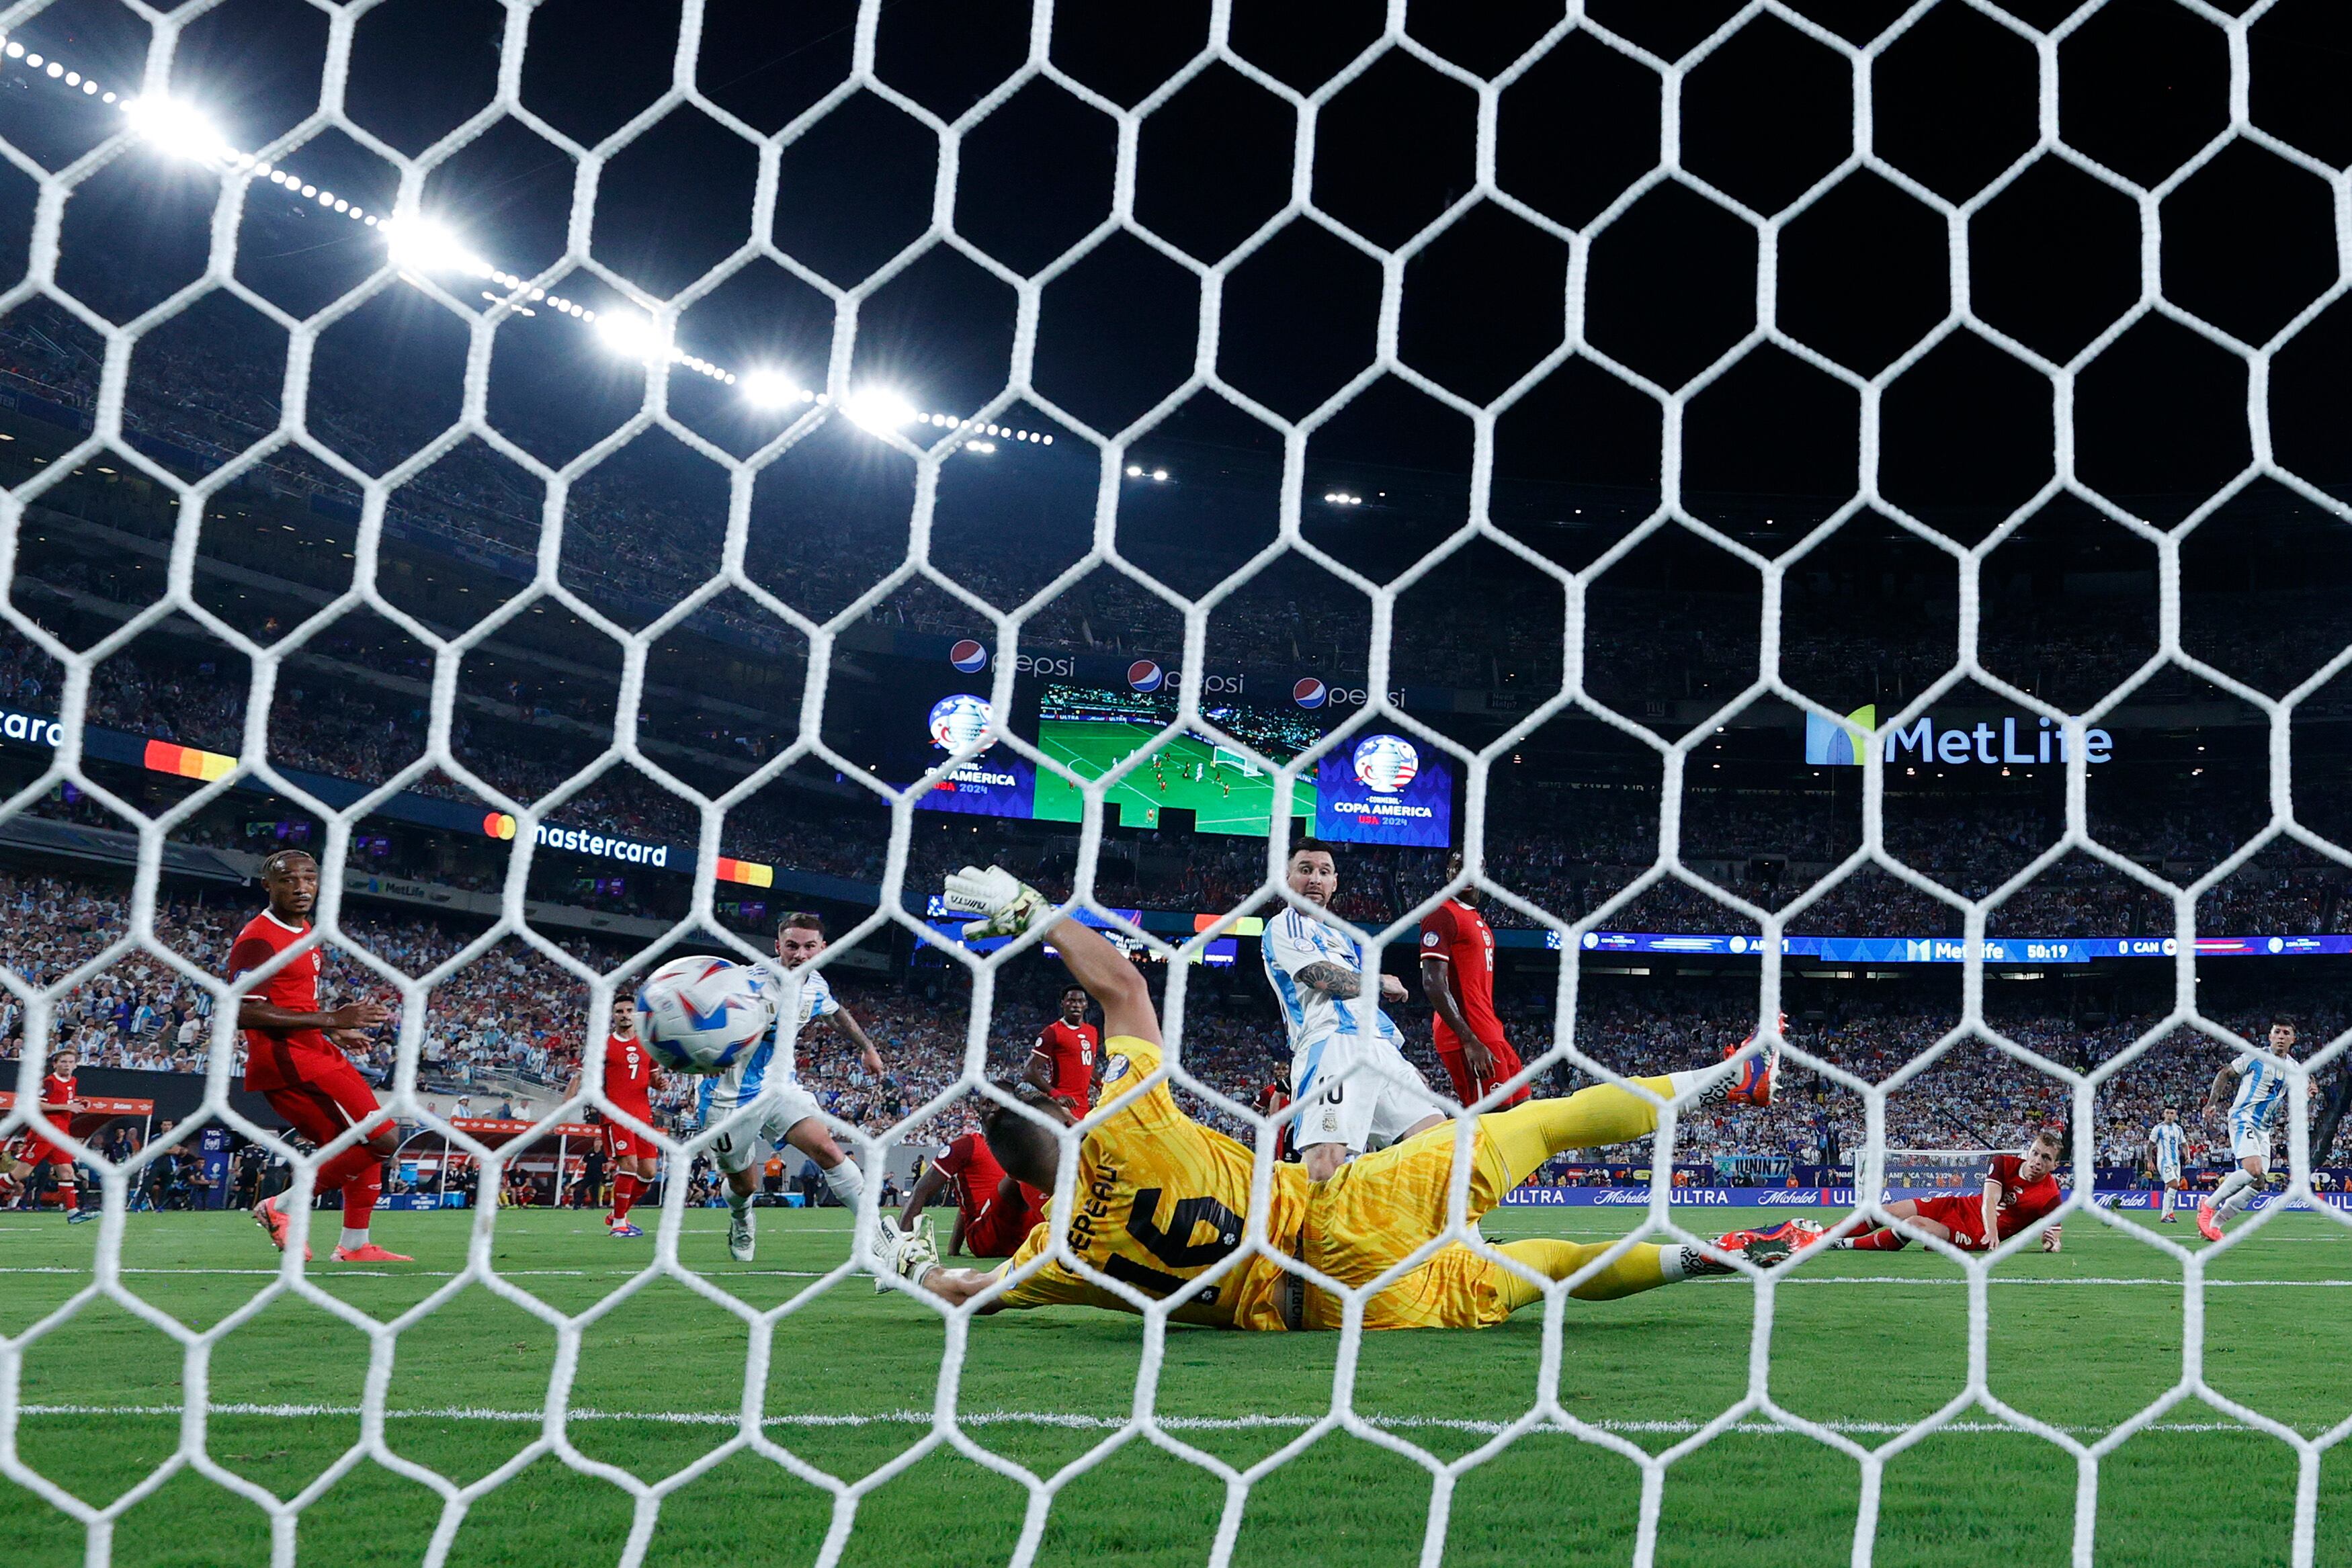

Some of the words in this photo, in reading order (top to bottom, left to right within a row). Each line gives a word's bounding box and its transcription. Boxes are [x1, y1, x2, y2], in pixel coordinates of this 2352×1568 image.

[1164, 672, 1244, 695] ppsi
[1329, 687, 1405, 708] pesi
[949, 771, 1015, 786] AMERICA
[960, 783, 988, 794] 2024
[1334, 802, 1370, 814] COPA
[1372, 804, 1432, 817] AMERICA
[1358, 816, 1380, 825] USA
[1382, 817, 1407, 826] 2024
[1935, 943, 2004, 959] Metife
[2027, 945, 2068, 959] 50:19
[2119, 941, 2128, 954] 0
[2133, 942, 2159, 953] CAN
[1081, 1050, 1092, 1066] 10
[628, 1064, 639, 1080] 7
[1318, 1075, 1343, 1105] 10
[1775, 1160, 1790, 1176] 77
[1505, 1190, 1564, 1204] ULTRA
[1670, 1190, 1728, 1204] ULTRA
[1758, 1190, 1818, 1205] Michelob
[1056, 1164, 1118, 1274] EPEAU
